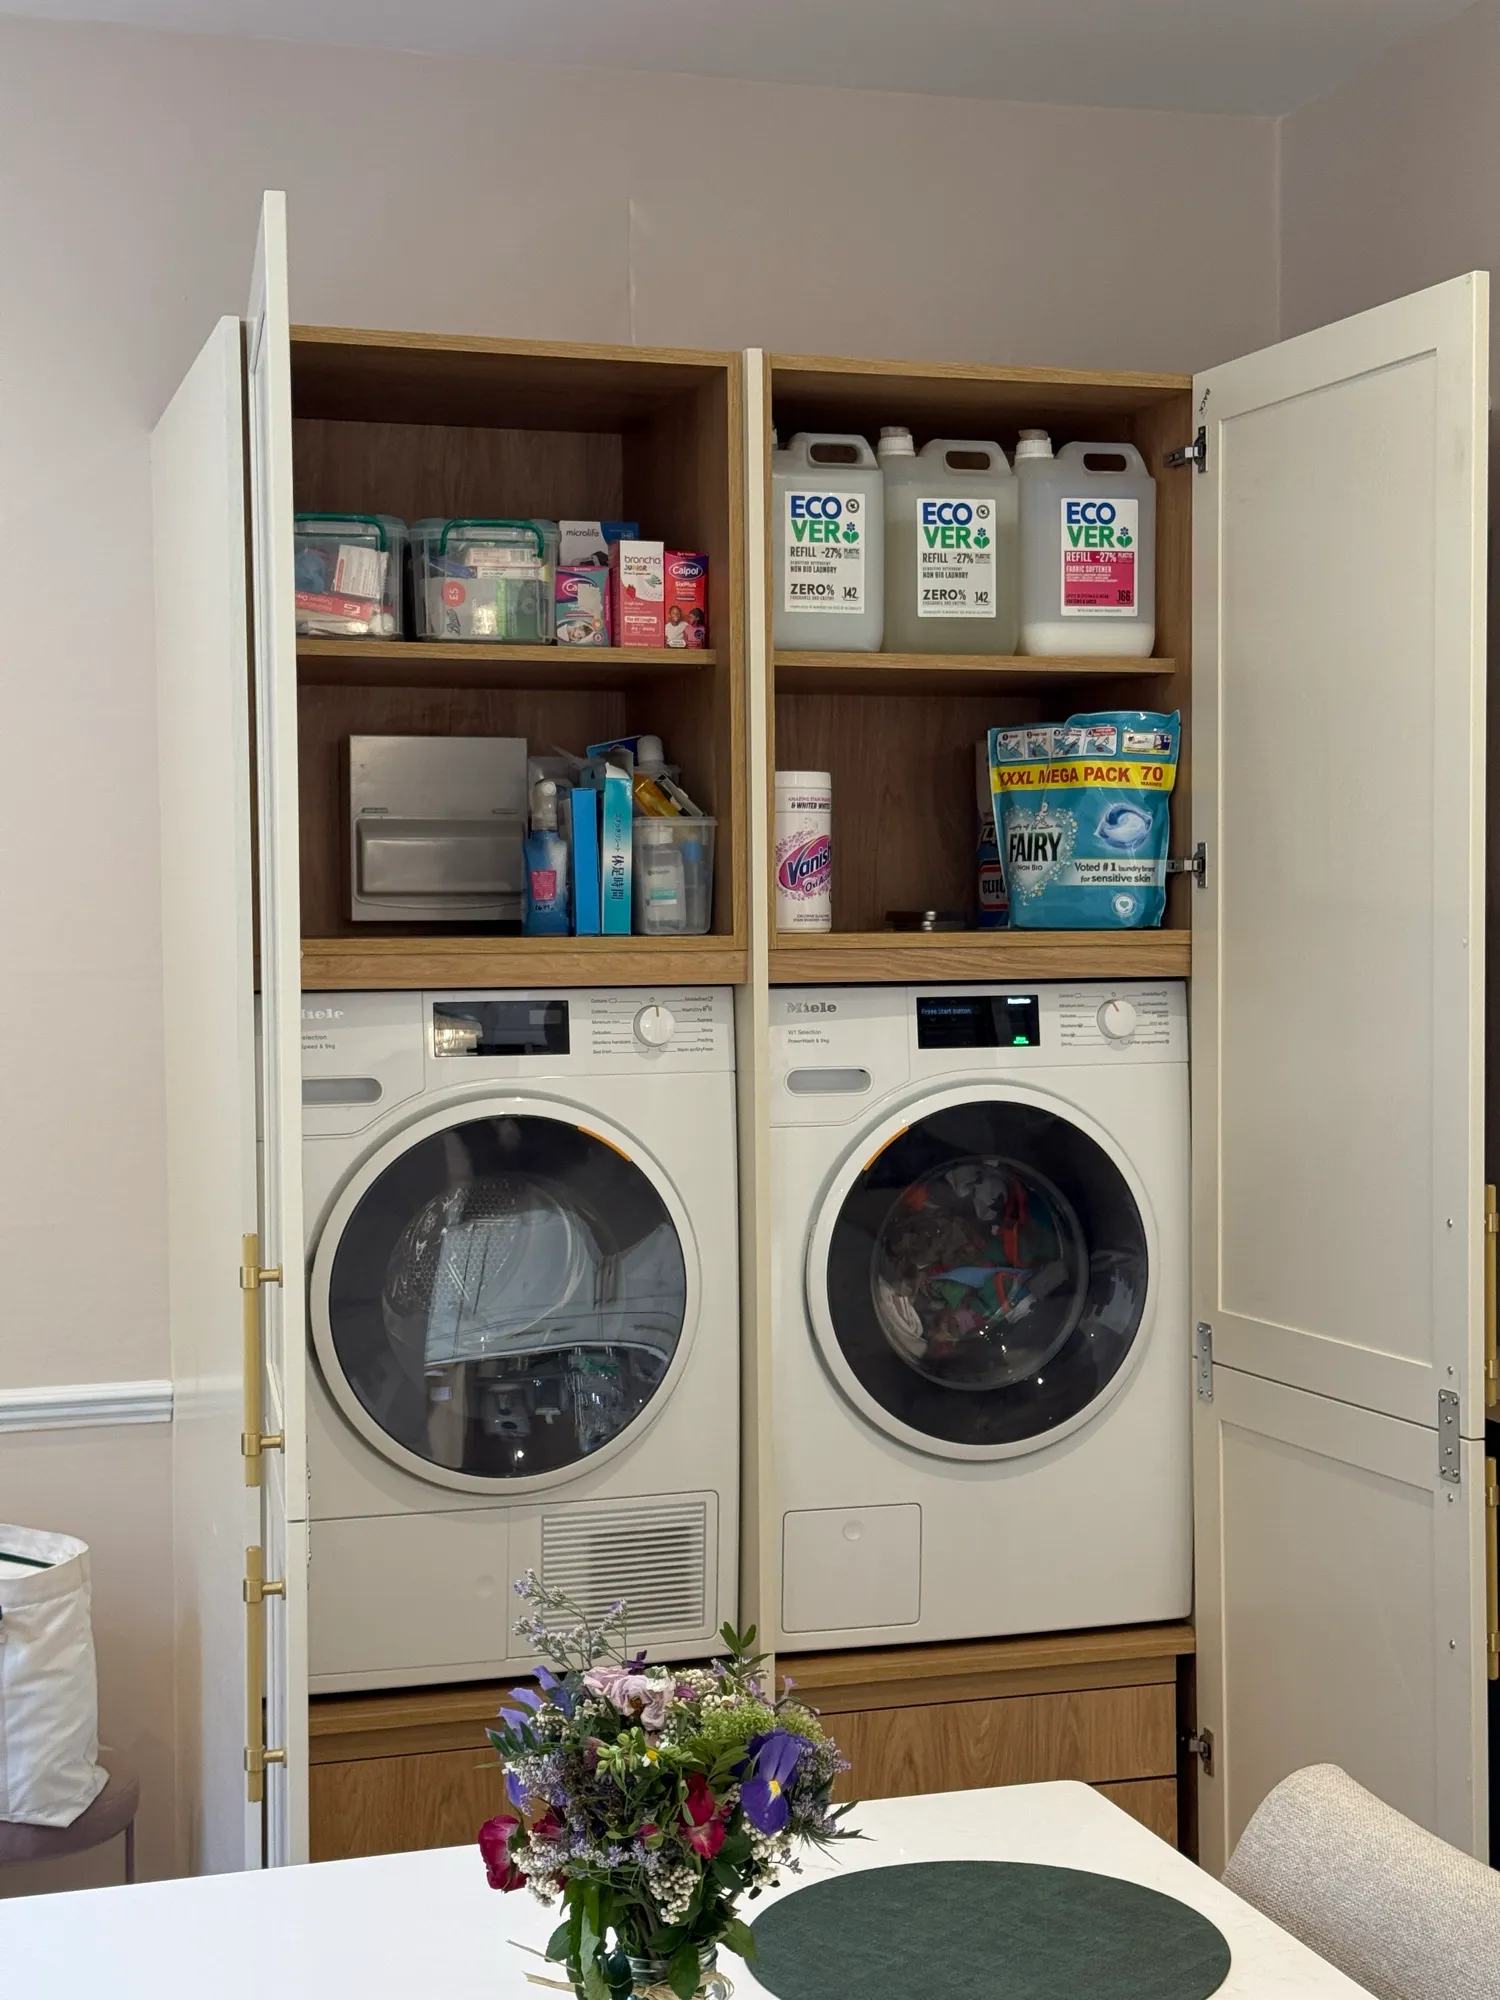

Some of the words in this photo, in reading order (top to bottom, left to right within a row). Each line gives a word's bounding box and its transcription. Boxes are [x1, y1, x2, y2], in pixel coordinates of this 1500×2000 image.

[791, 495, 842, 520] ECO
[1066, 502, 1116, 525] ECO
[922, 502, 973, 526] ECO
[566, 528, 600, 538] microlife
[790, 520, 842, 544] VER
[923, 526, 973, 549] VER
[1066, 526, 1116, 548] VER
[790, 546, 817, 558] REFILL
[821, 547, 842, 559] -27%
[922, 553, 949, 564] REFILL
[952, 553, 974, 564] -27%
[1066, 552, 1092, 562] REFILL
[1096, 552, 1117, 563] -27%
[672, 564, 699, 576] Calpol
[790, 584, 835, 596] ZERO%
[843, 586, 858, 598] 142
[923, 589, 966, 601] ZERO%
[974, 592, 989, 603] 142
[1038, 768, 1079, 784] MEGA
[1084, 766, 1131, 783] PACK
[1140, 766, 1164, 782] 70
[1009, 832, 1063, 863] FAIRY
[1075, 862, 1100, 872] Voted
[1118, 865, 1142, 874] laundry
[611, 855, 625, 900] 休足時間
[1091, 874, 1132, 883] sensitive
[302, 1008, 344, 1019] iele
[787, 1002, 837, 1013] Miele
